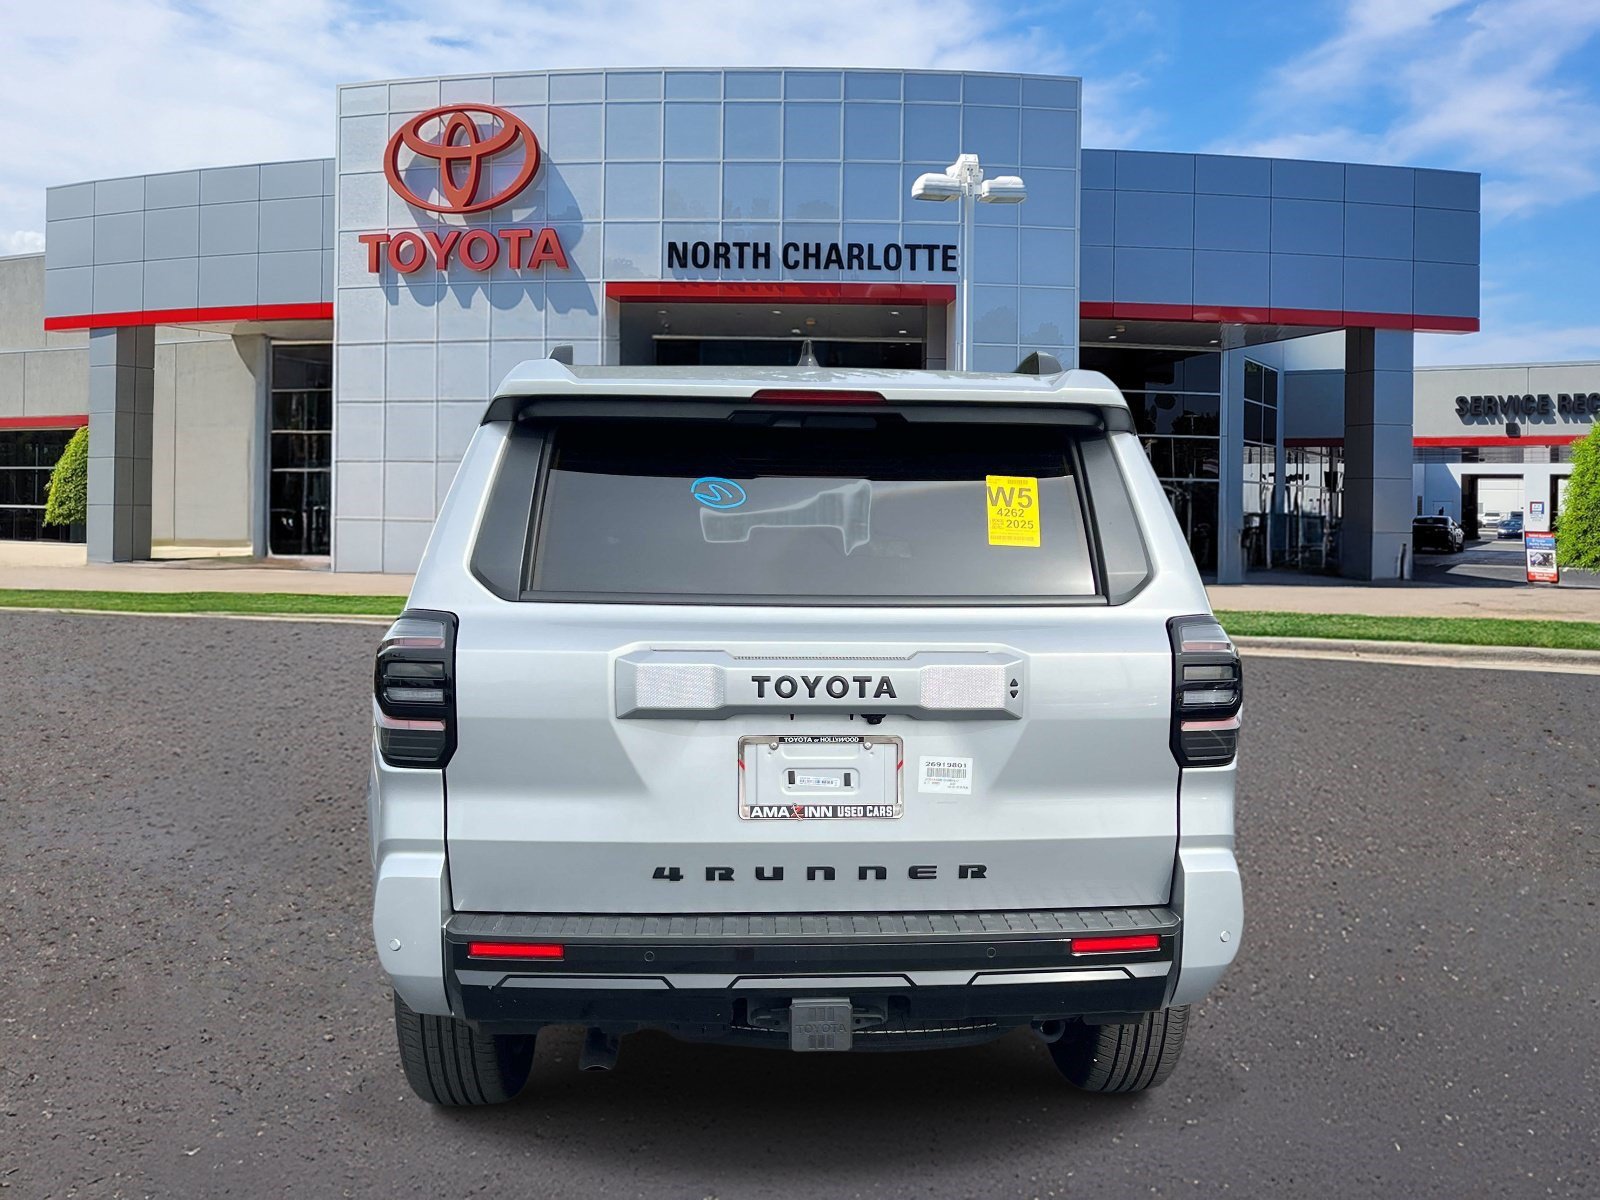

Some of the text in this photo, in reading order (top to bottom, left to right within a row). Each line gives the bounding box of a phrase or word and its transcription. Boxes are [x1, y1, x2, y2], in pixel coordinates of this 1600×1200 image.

[359, 228, 569, 273] TOYOTA
[667, 241, 958, 272] NORTH CHARLOTTE
[1455, 394, 1551, 416] SERVICE
[987, 486, 1033, 508] W5
[997, 508, 1025, 518] 4262
[1006, 519, 1034, 529] 2025
[751, 675, 898, 699] TOYOTA
[837, 806, 864, 817] USED
[866, 805, 894, 817] CARS
[652, 864, 988, 881] 4RUNNER
[795, 1023, 847, 1034] TOYOTA
